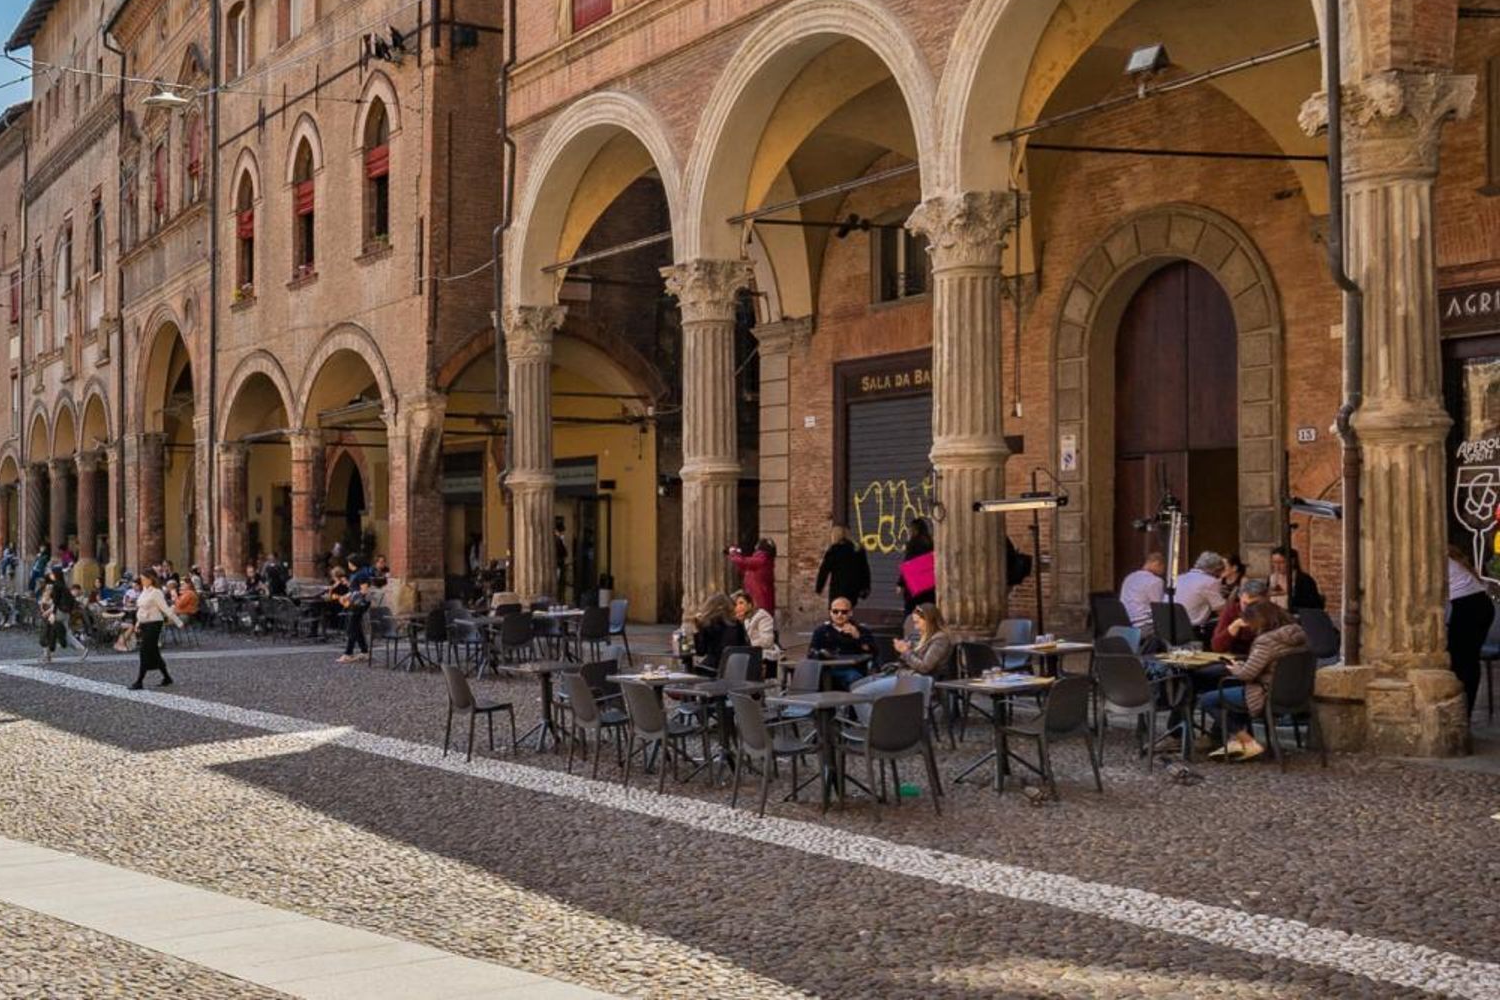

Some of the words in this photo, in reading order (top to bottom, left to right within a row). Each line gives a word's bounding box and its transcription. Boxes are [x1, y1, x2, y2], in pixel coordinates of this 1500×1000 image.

[861, 376, 891, 391] SALA
[894, 374, 910, 388] DA
[1456, 438, 1500, 458] APEROL
